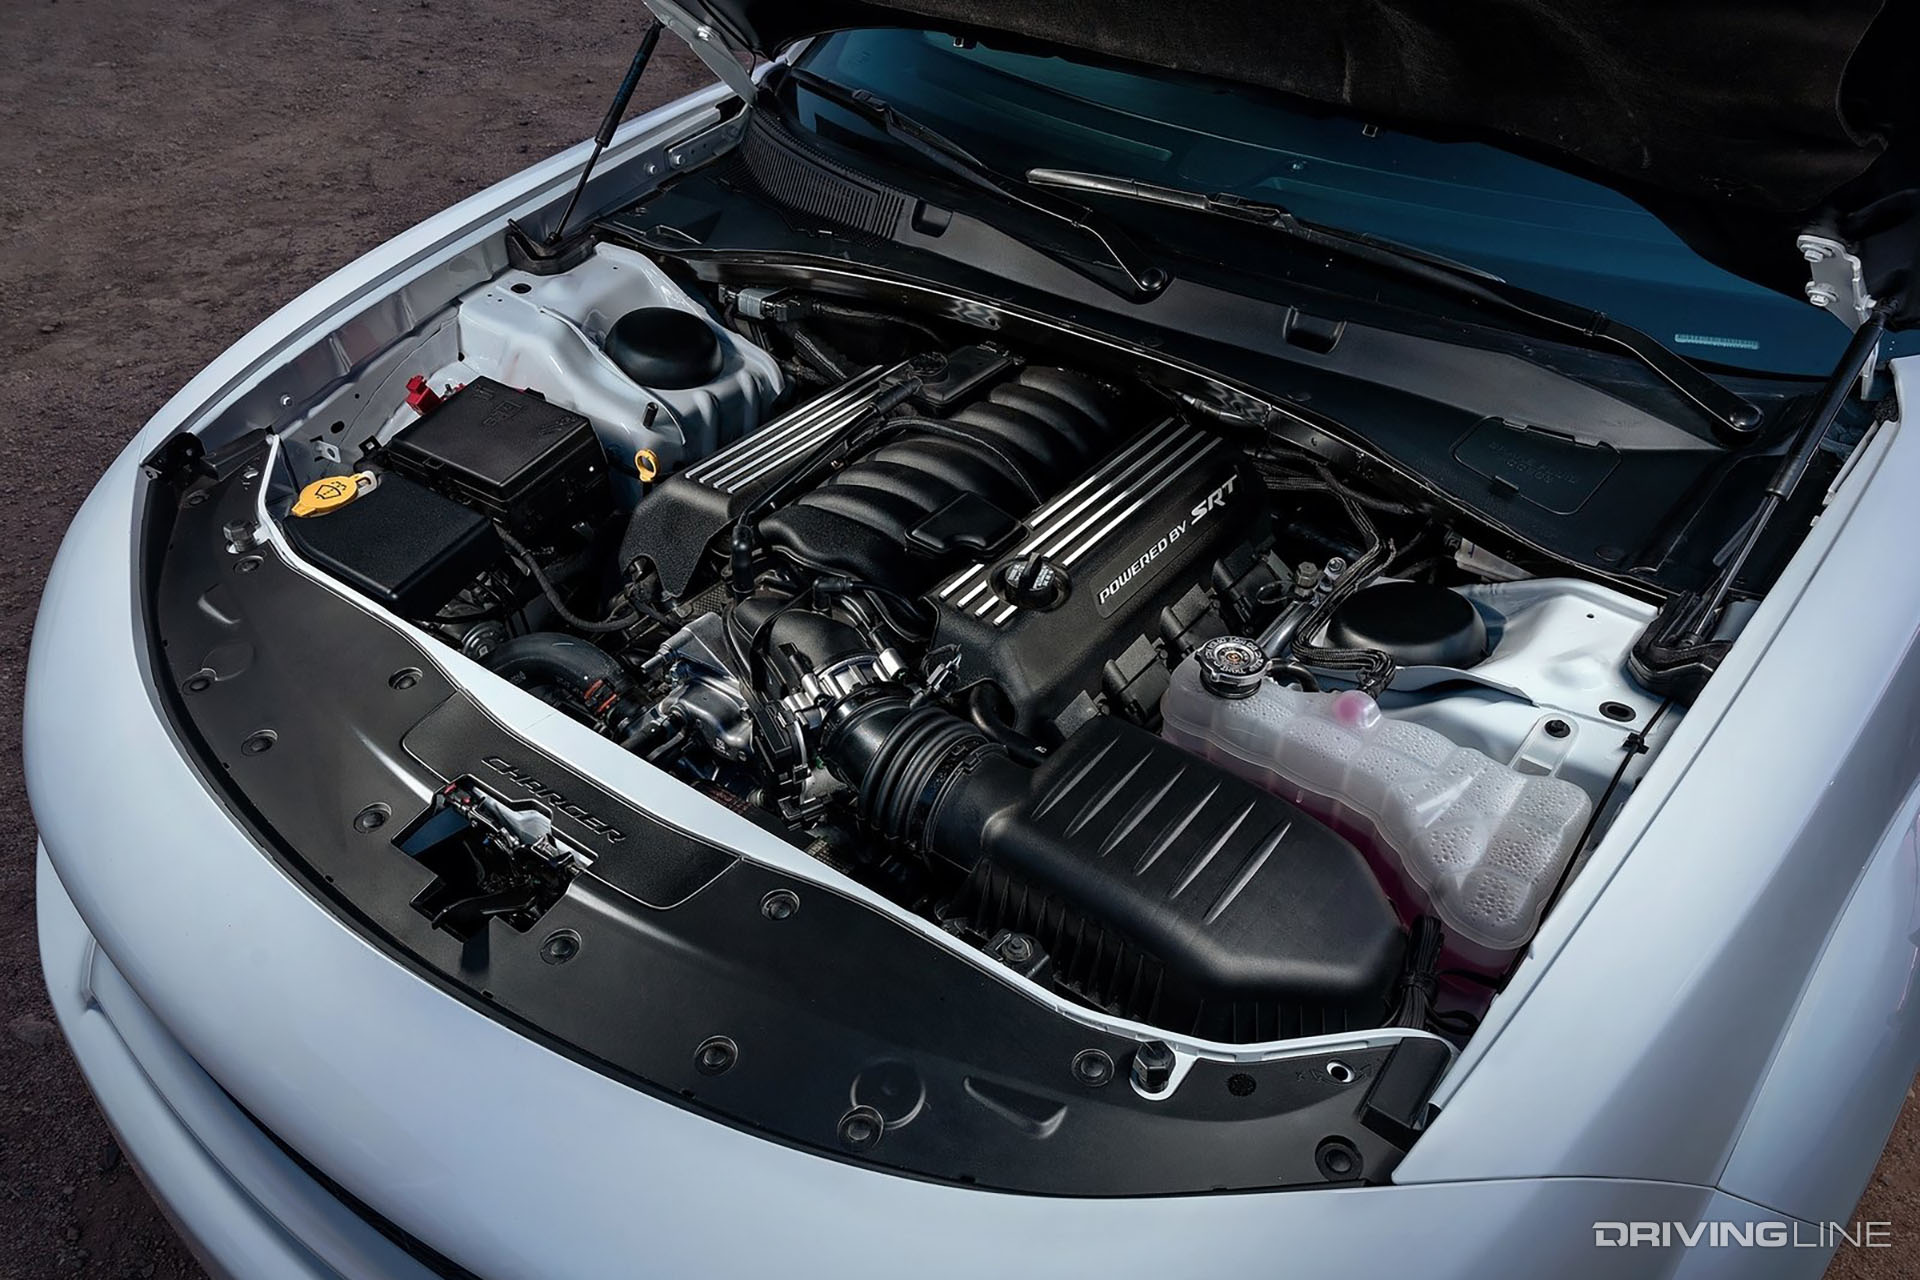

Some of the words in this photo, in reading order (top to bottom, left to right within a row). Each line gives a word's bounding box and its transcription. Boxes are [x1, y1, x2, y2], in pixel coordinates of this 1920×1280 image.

[1098, 538, 1169, 604] POWERED
[1169, 520, 1187, 543] BY
[1191, 474, 1238, 525] SRT
[480, 756, 626, 844] CHARGER
